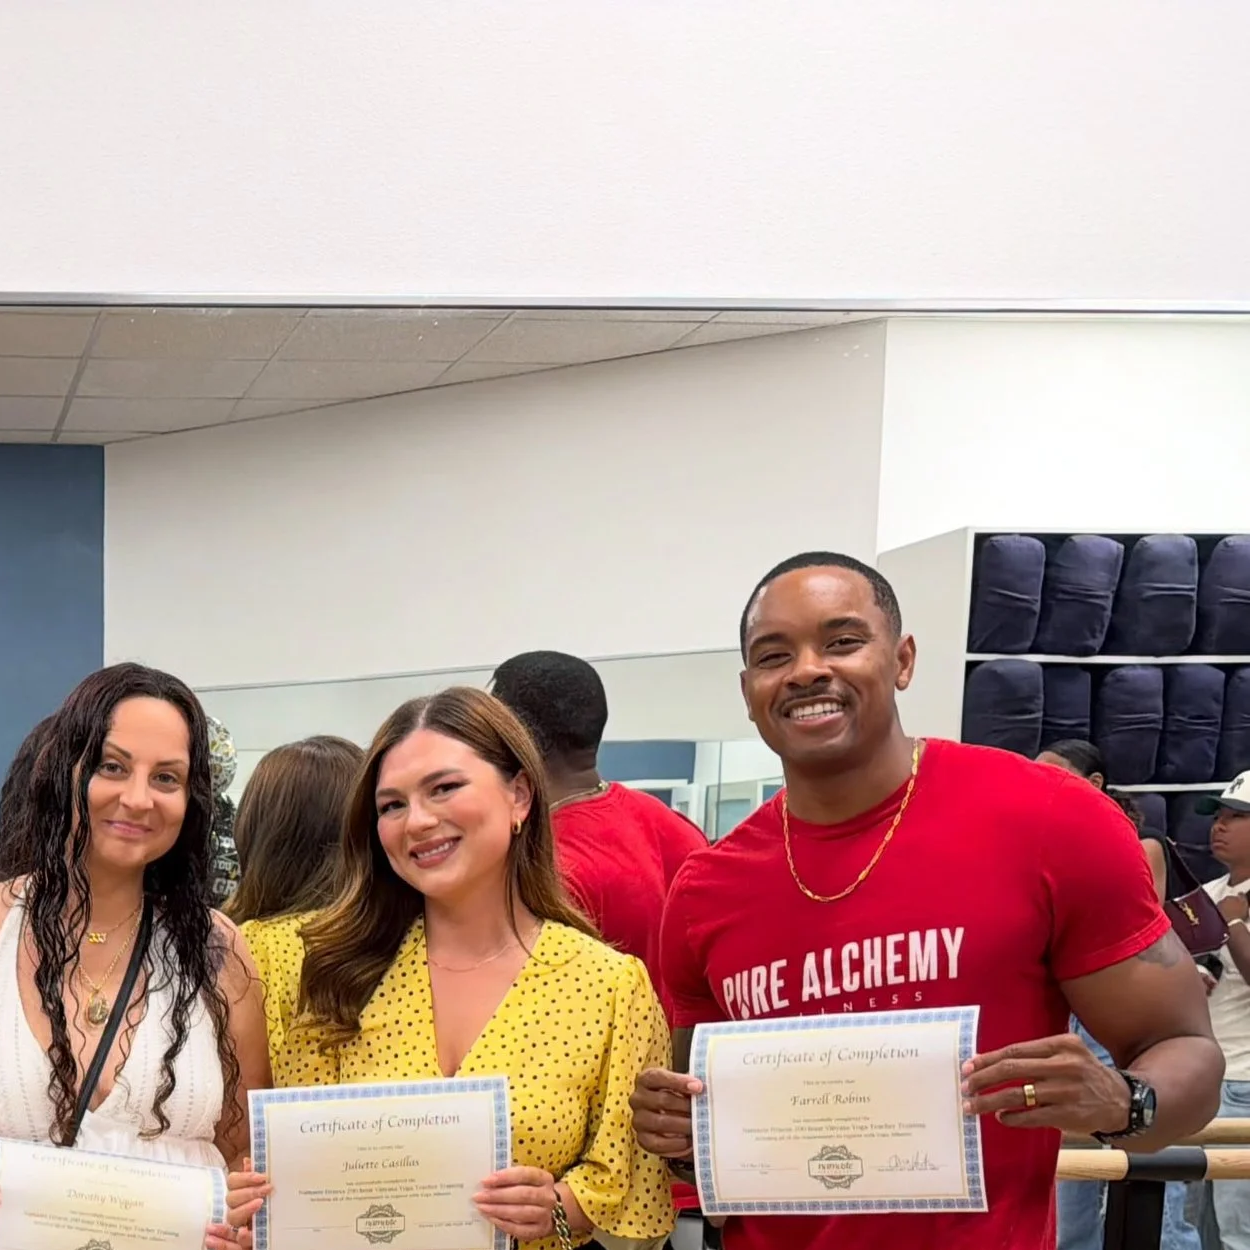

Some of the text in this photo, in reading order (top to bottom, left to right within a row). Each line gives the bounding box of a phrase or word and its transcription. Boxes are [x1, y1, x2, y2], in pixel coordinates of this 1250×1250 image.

[721, 927, 965, 1021] PURE ALCHEMY
[742, 1042, 920, 1070] Certificate of Completion
[791, 1091, 871, 1106] Farrell Robins
[300, 1111, 460, 1137] Certificate of Completion
[341, 1155, 420, 1173] Juliette Casillas
